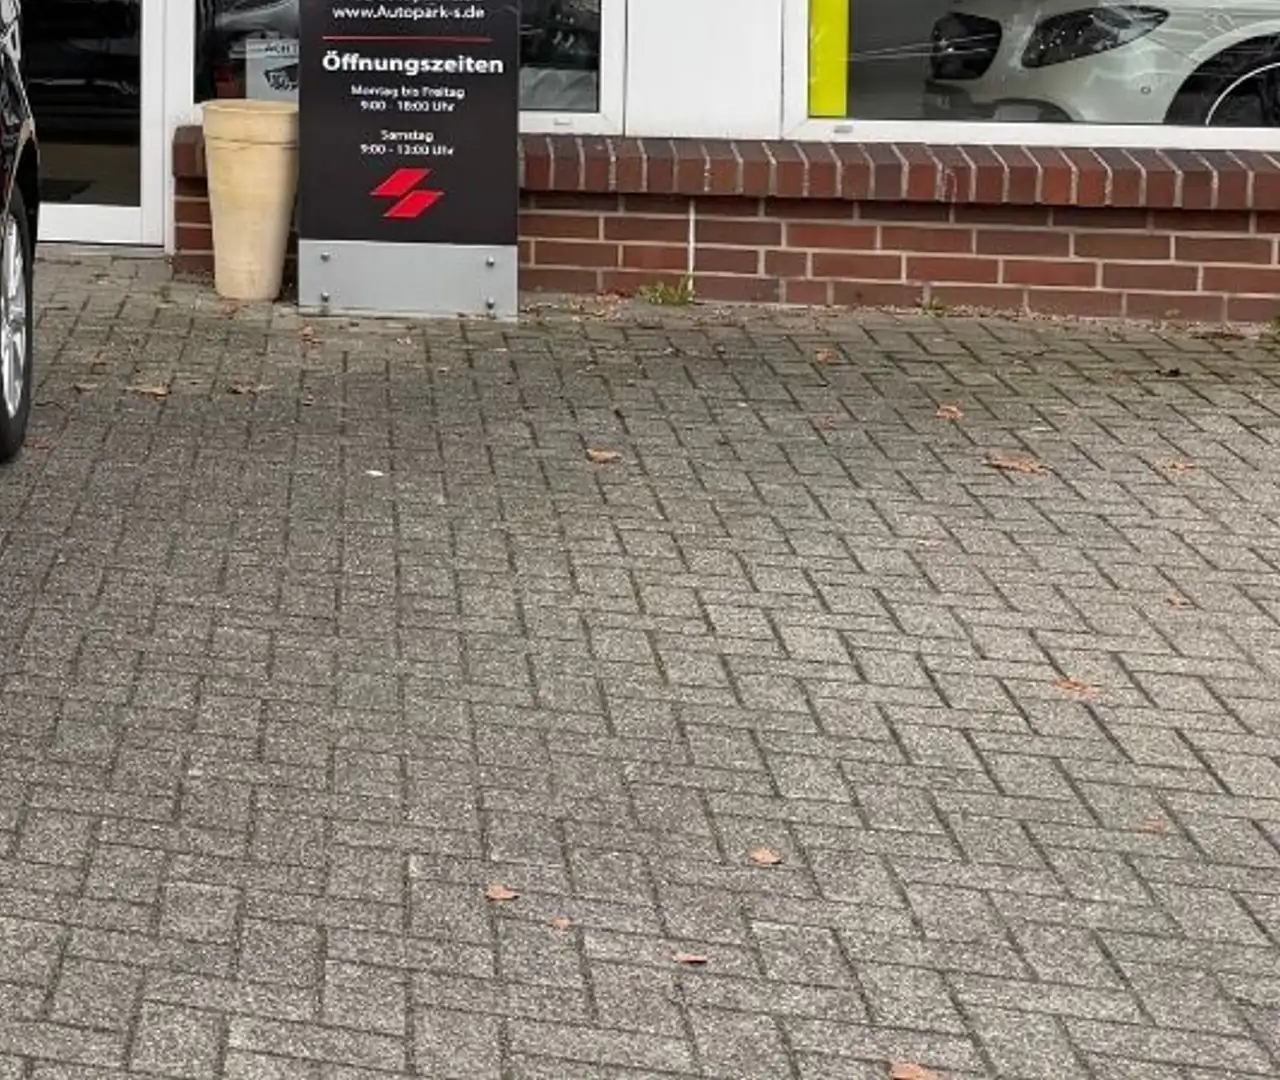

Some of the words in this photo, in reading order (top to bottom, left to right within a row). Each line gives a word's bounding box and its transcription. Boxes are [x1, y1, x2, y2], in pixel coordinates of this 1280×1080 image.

[322, 50, 504, 75] Öffnungszeiten
[432, 101, 455, 112] Uhr
[380, 130, 434, 142] Samstag
[361, 144, 386, 155] 9:00
[432, 144, 454, 156] Uhr
